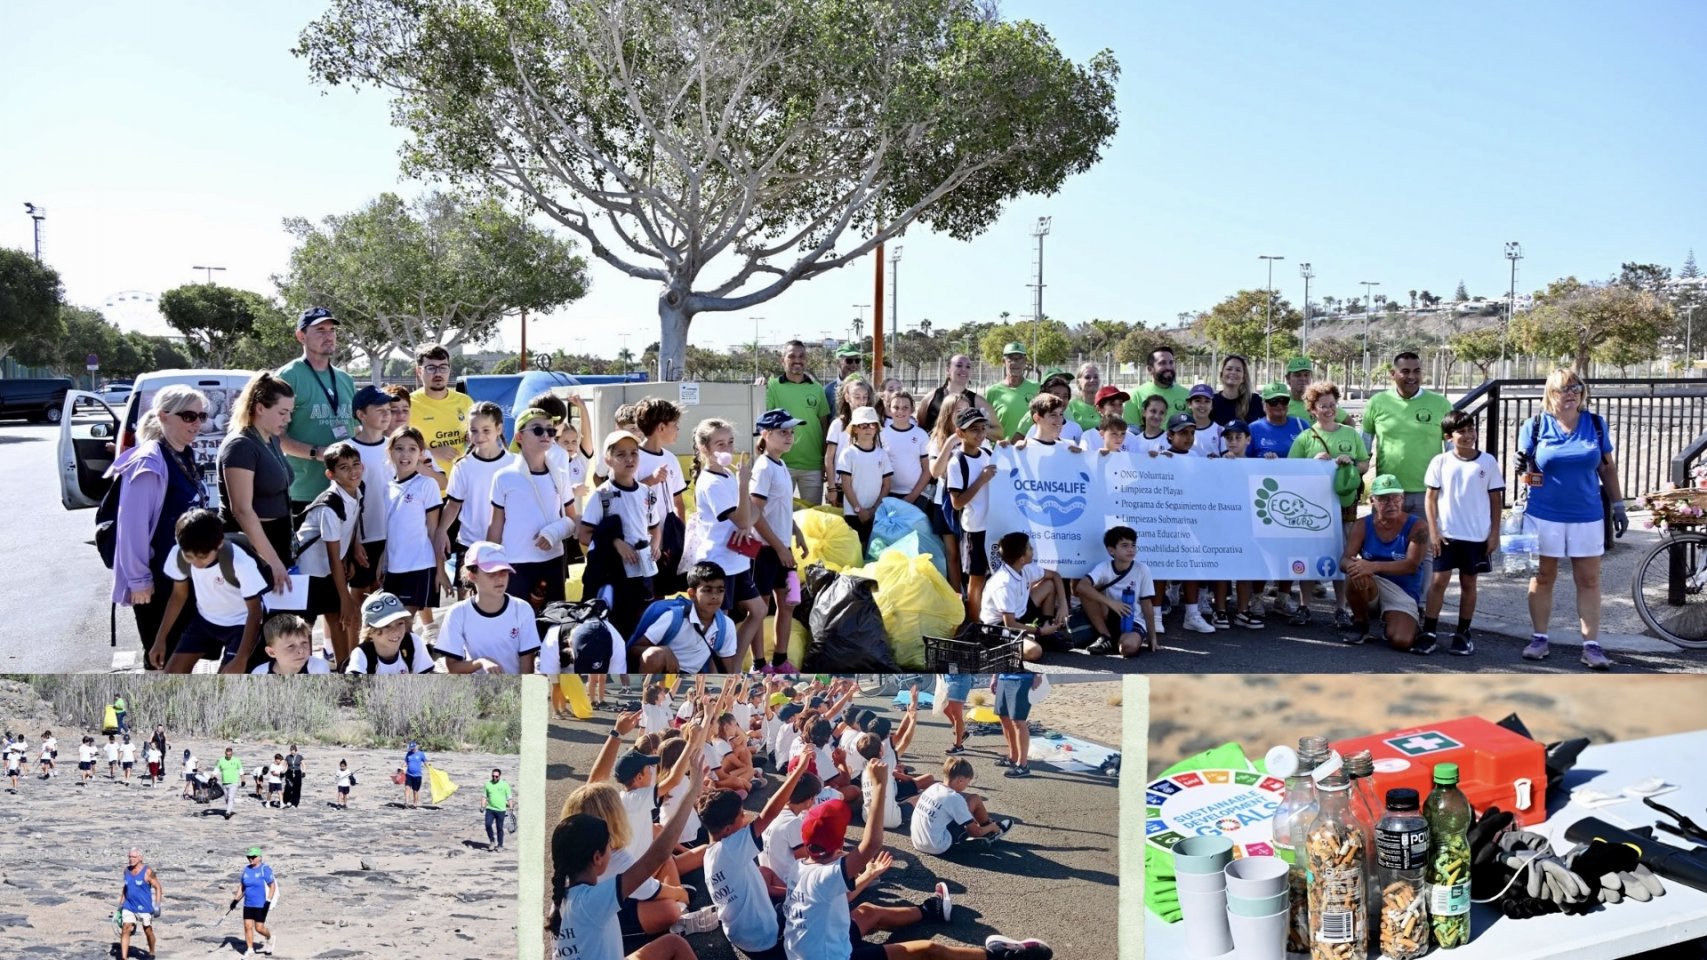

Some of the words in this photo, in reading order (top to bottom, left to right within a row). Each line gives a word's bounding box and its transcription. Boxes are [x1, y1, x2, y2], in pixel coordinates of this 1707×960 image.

[435, 430, 460, 439] Gran
[1120, 470, 1138, 479] ONG
[1139, 471, 1175, 481] Voluntaria
[1014, 479, 1087, 494] OCEANS4LIFE
[1121, 484, 1152, 495] Limpieza
[1153, 486, 1162, 494] de
[1163, 486, 1184, 497] Playas
[1121, 499, 1155, 510] Programa
[1156, 501, 1164, 509] de
[1165, 500, 1207, 511] Seguimiento
[1208, 502, 1216, 510] de
[1217, 502, 1242, 511] Basura
[1122, 513, 1158, 525] Limpiezas
[1158, 514, 1198, 524] Submarinas
[1044, 530, 1082, 541] Canarias
[1157, 530, 1191, 539] Educativo
[1181, 545, 1201, 554] Social
[1202, 545, 1243, 556] Corporativa
[1166, 559, 1175, 568] de
[1176, 560, 1188, 568] Eco
[1189, 560, 1219, 568] Turismo
[1173, 789, 1260, 823] SUSTAINABLE
[1182, 796, 1269, 829] DEVELOPMENT
